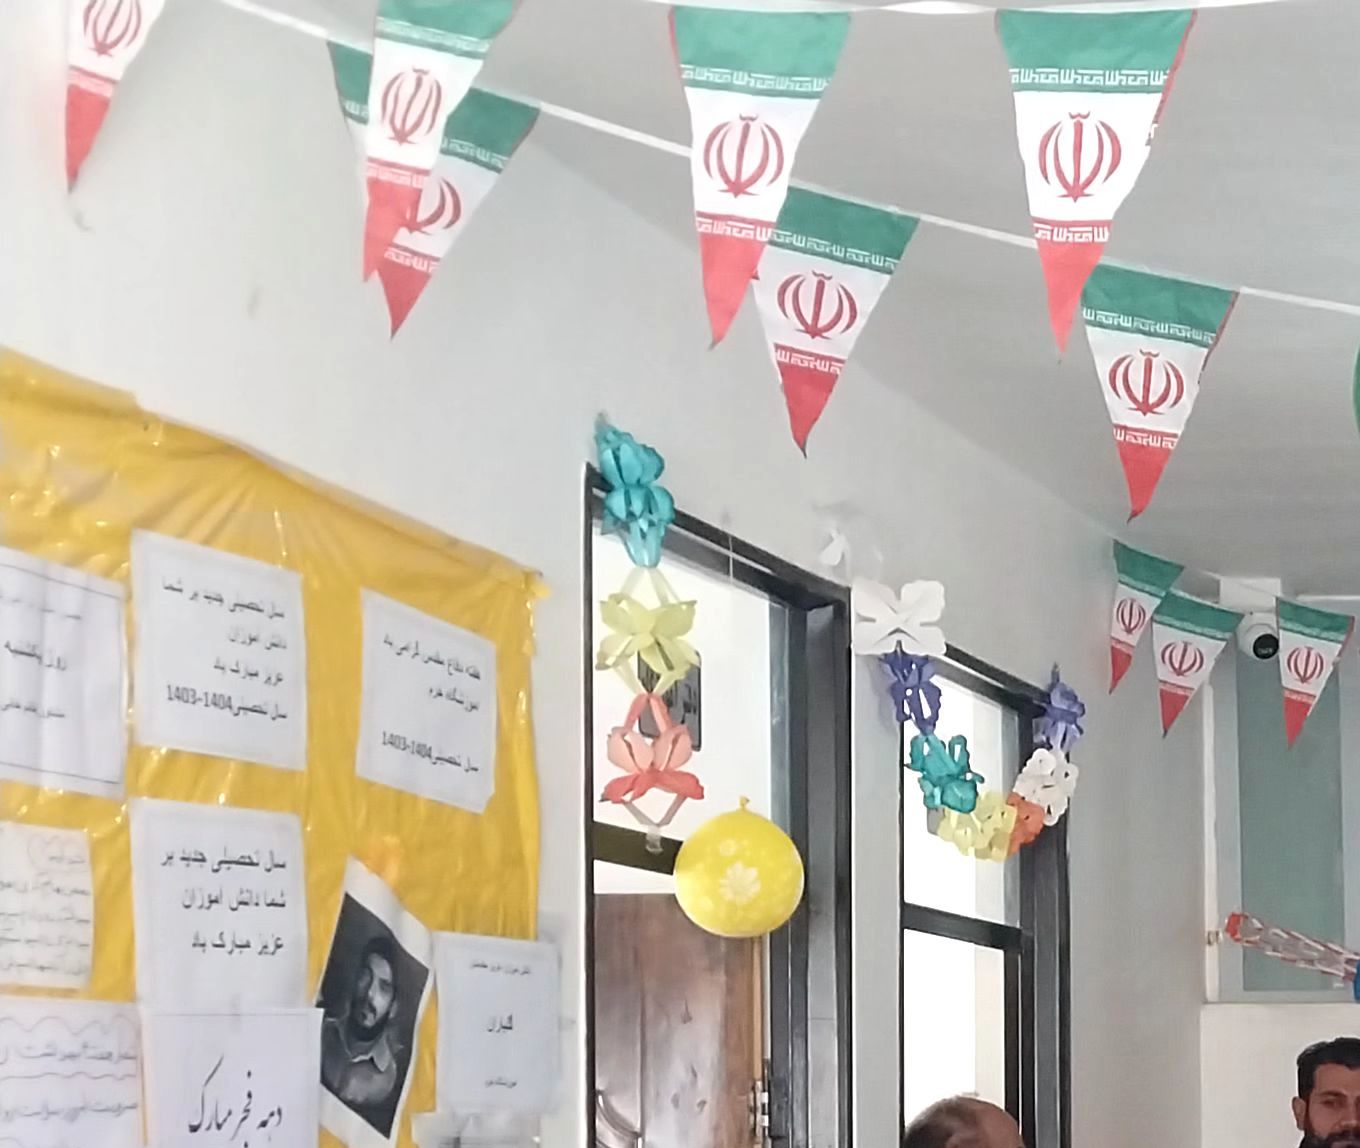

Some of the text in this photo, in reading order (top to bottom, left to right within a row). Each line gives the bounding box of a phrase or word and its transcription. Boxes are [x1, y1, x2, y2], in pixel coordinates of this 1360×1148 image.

[210, 845, 260, 874] تحصیلی
[263, 848, 287, 874] سال
[210, 930, 252, 956] مبارک
[256, 932, 285, 956] عزیز
[255, 1104, 284, 1143] دهه
